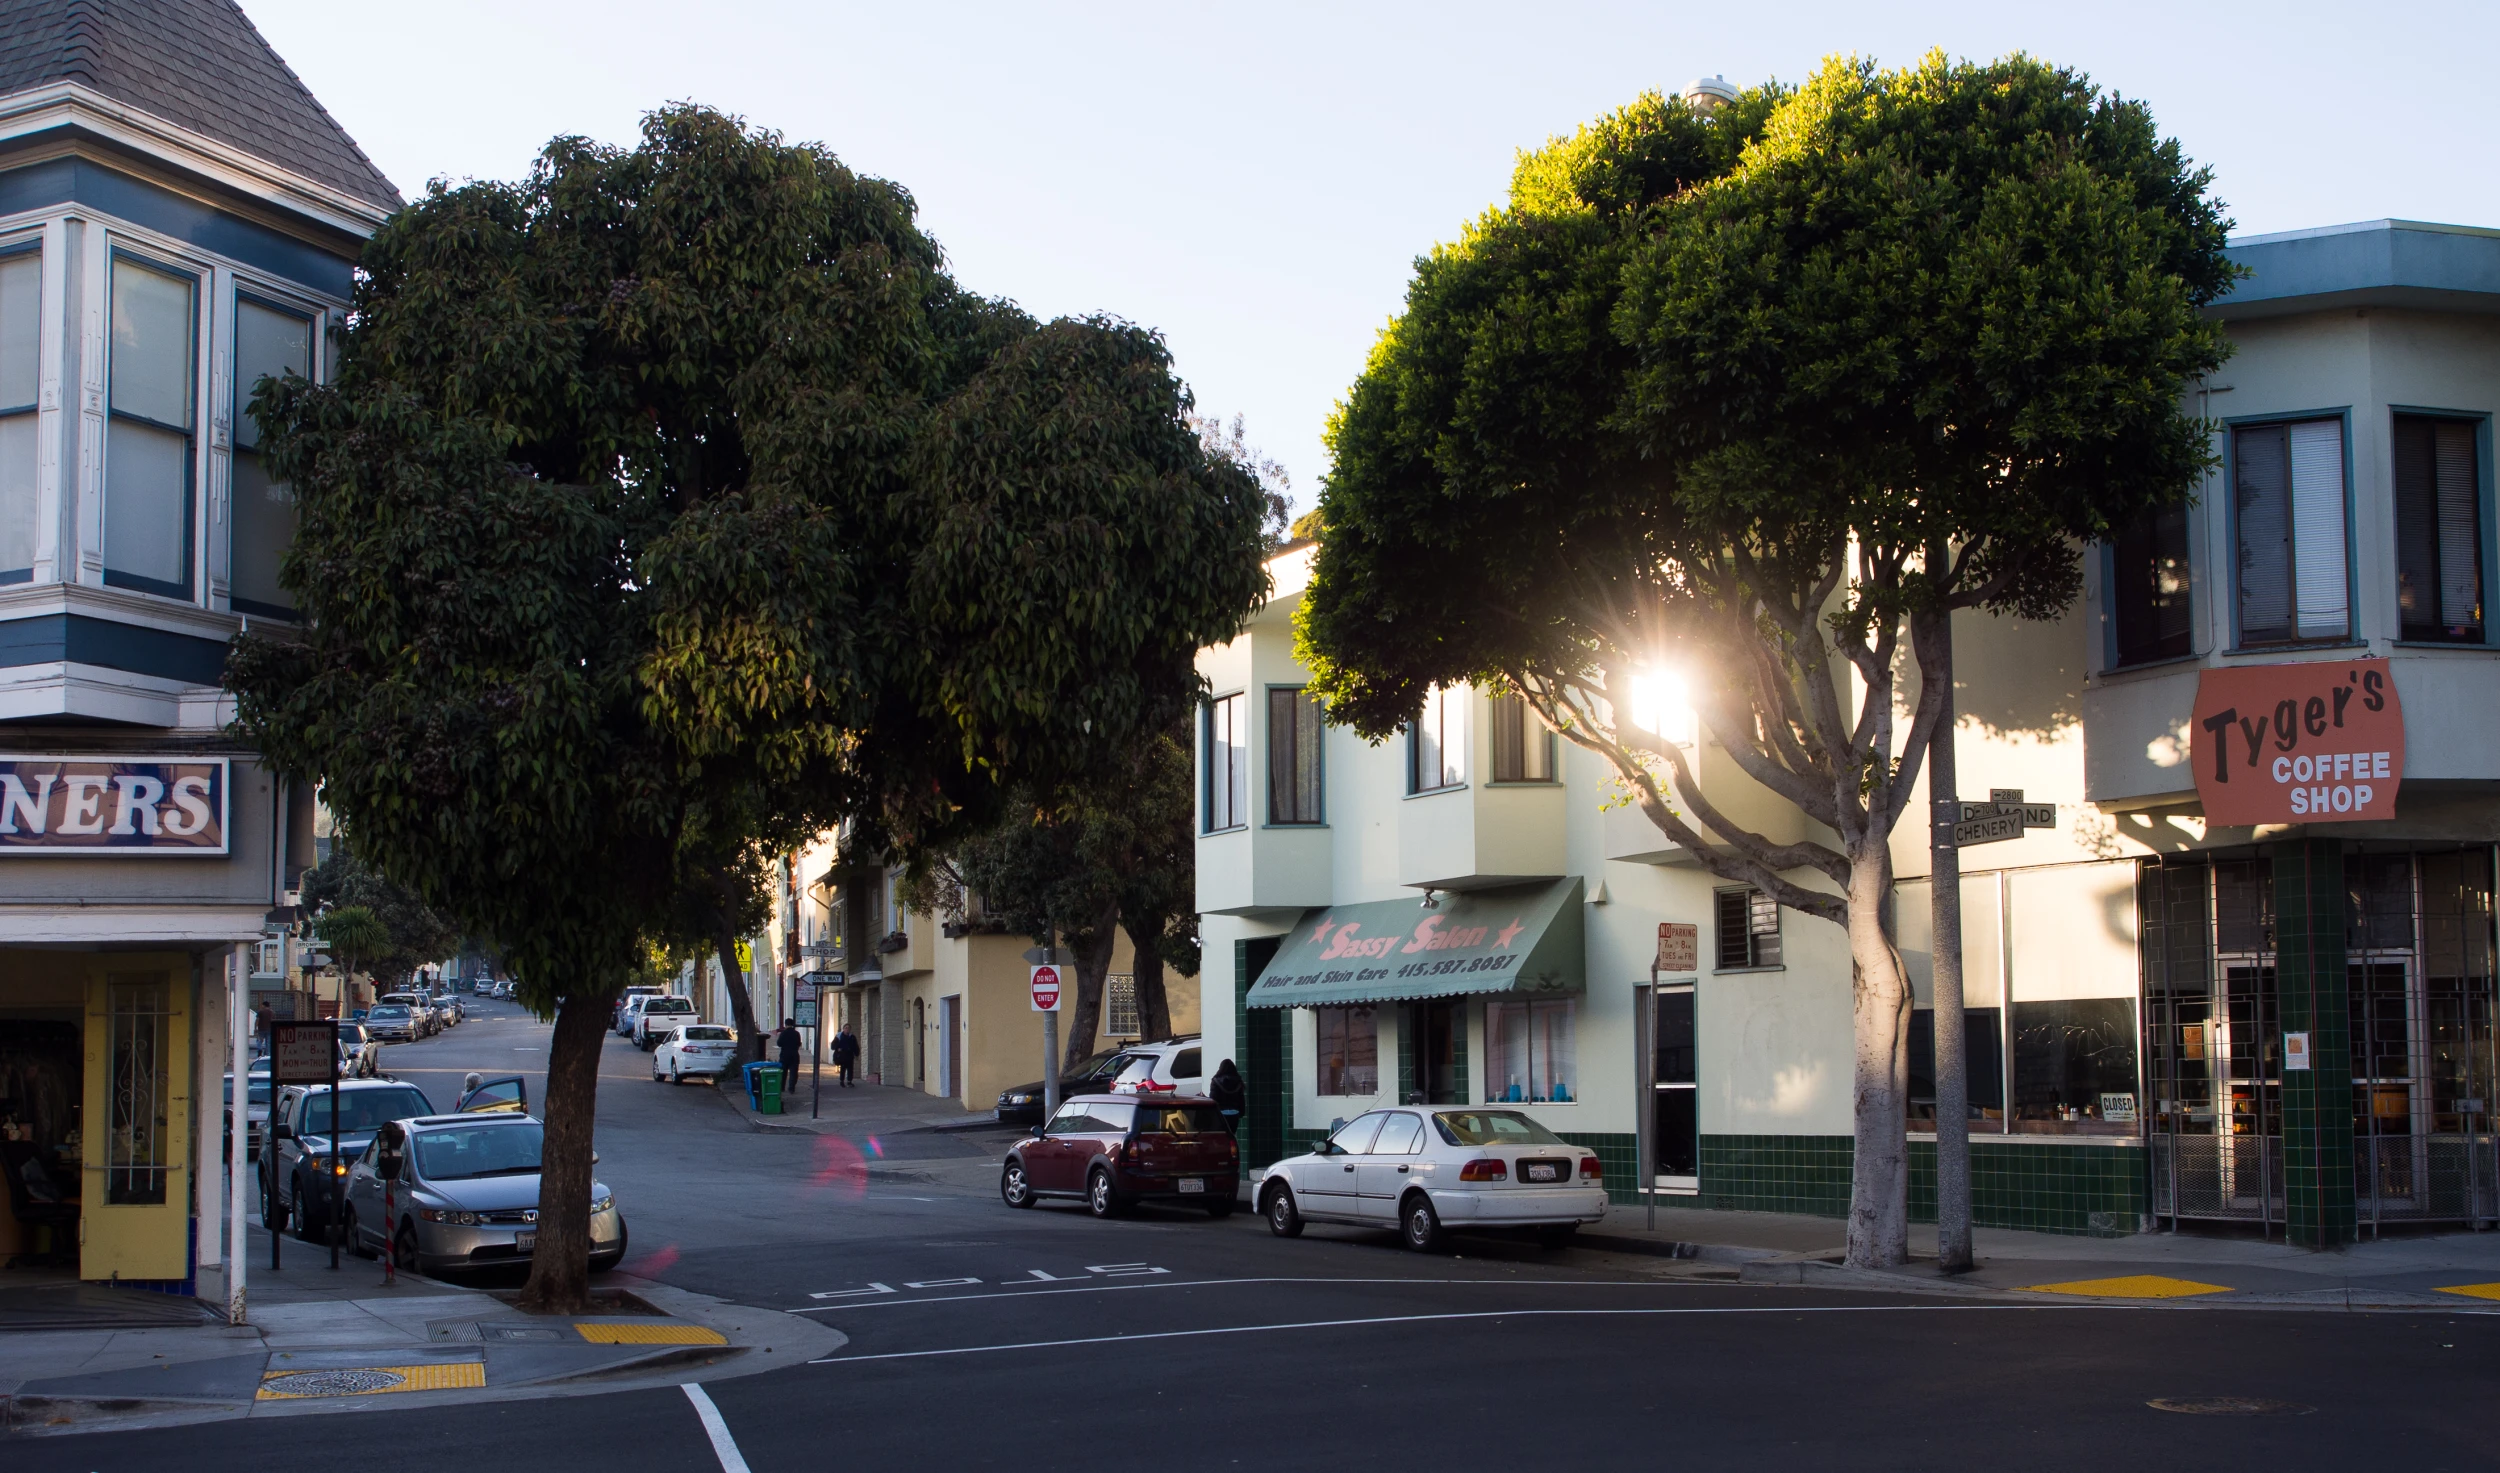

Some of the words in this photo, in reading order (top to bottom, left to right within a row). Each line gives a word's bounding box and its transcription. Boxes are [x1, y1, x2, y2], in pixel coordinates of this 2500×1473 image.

[2203, 670, 2384, 784] Tyger's
[2272, 752, 2391, 784] COFFEE
[2001, 790, 2022, 800] 2800
[2290, 785, 2373, 815] SHOP
[0, 774, 210, 836] NERS
[1981, 804, 1995, 815] 700
[1956, 818, 2017, 842] CHENERY
[1319, 922, 1402, 961] Sassy
[1401, 914, 1489, 954] Salon
[1660, 924, 1671, 937] NO
[1672, 928, 1695, 937] PARKING
[810, 948, 836, 956] THOR
[1262, 975, 1292, 988] Hair
[1294, 973, 1318, 986] and
[1321, 969, 1351, 983] Skin
[1356, 967, 1388, 981] Care
[1397, 954, 1519, 978] 415.587.8087
[279, 1028, 294, 1042] NO
[297, 1031, 331, 1041] PARKING
[282, 1059, 299, 1068] MON
[310, 1058, 328, 1067] THUR
[2103, 1097, 2133, 1111] CLOSED
